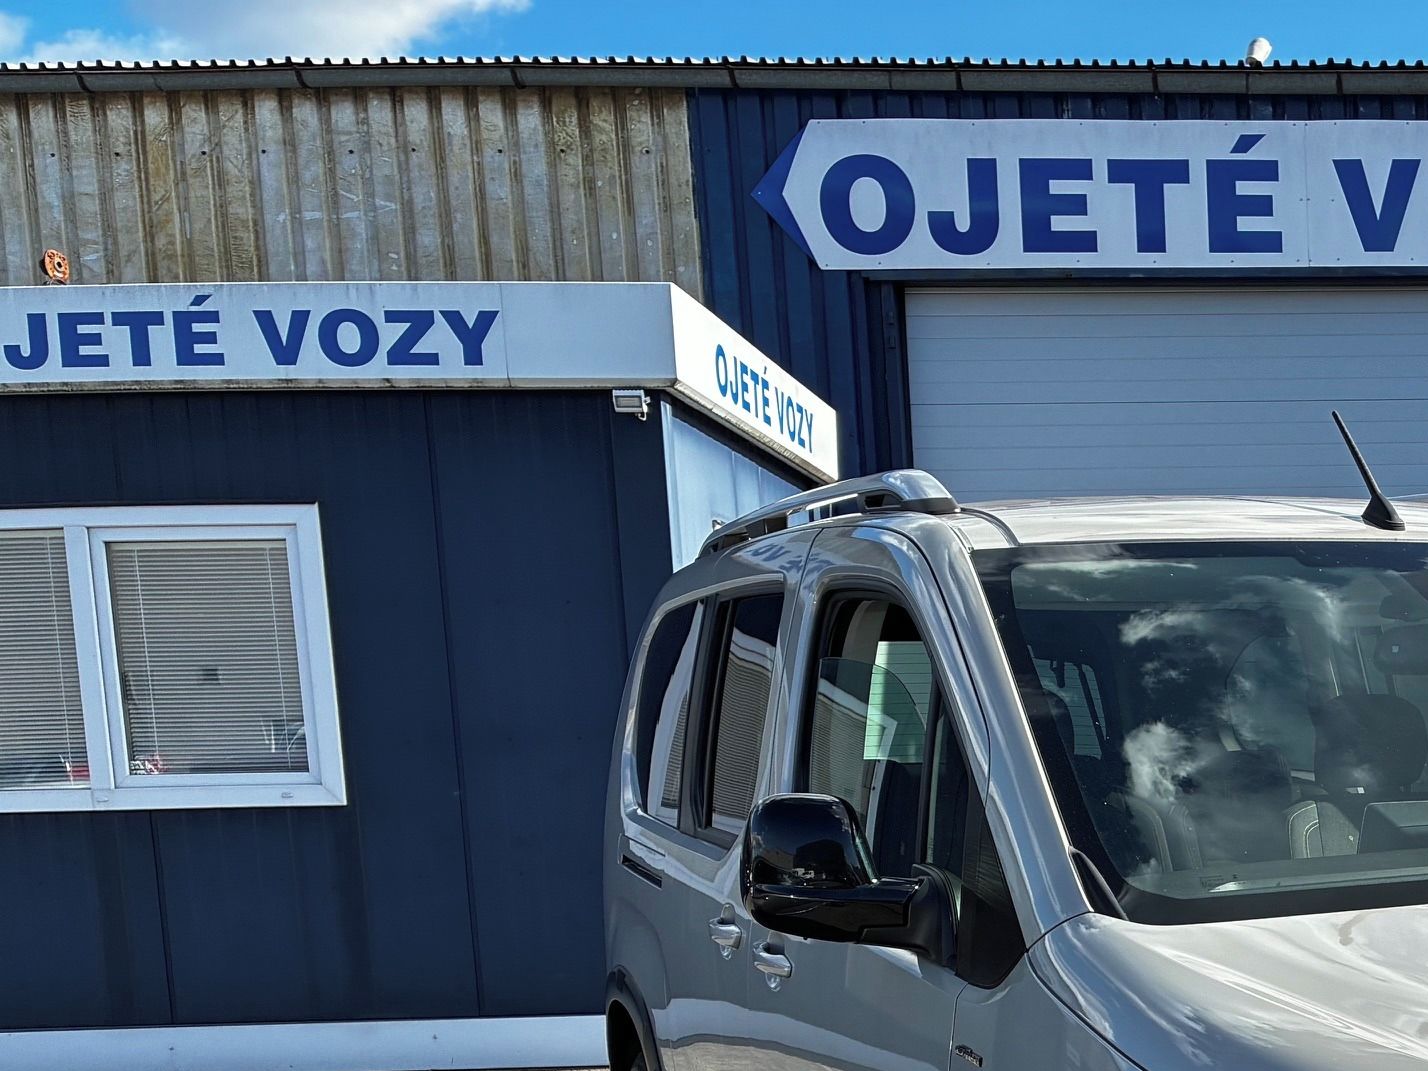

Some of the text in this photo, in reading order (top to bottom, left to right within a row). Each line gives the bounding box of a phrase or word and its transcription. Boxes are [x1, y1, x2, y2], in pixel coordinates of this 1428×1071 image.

[818, 134, 1283, 255] OJETÉ
[3, 294, 500, 370] JETÉ VOZY
[715, 343, 814, 454] OJETÉ VOZY
